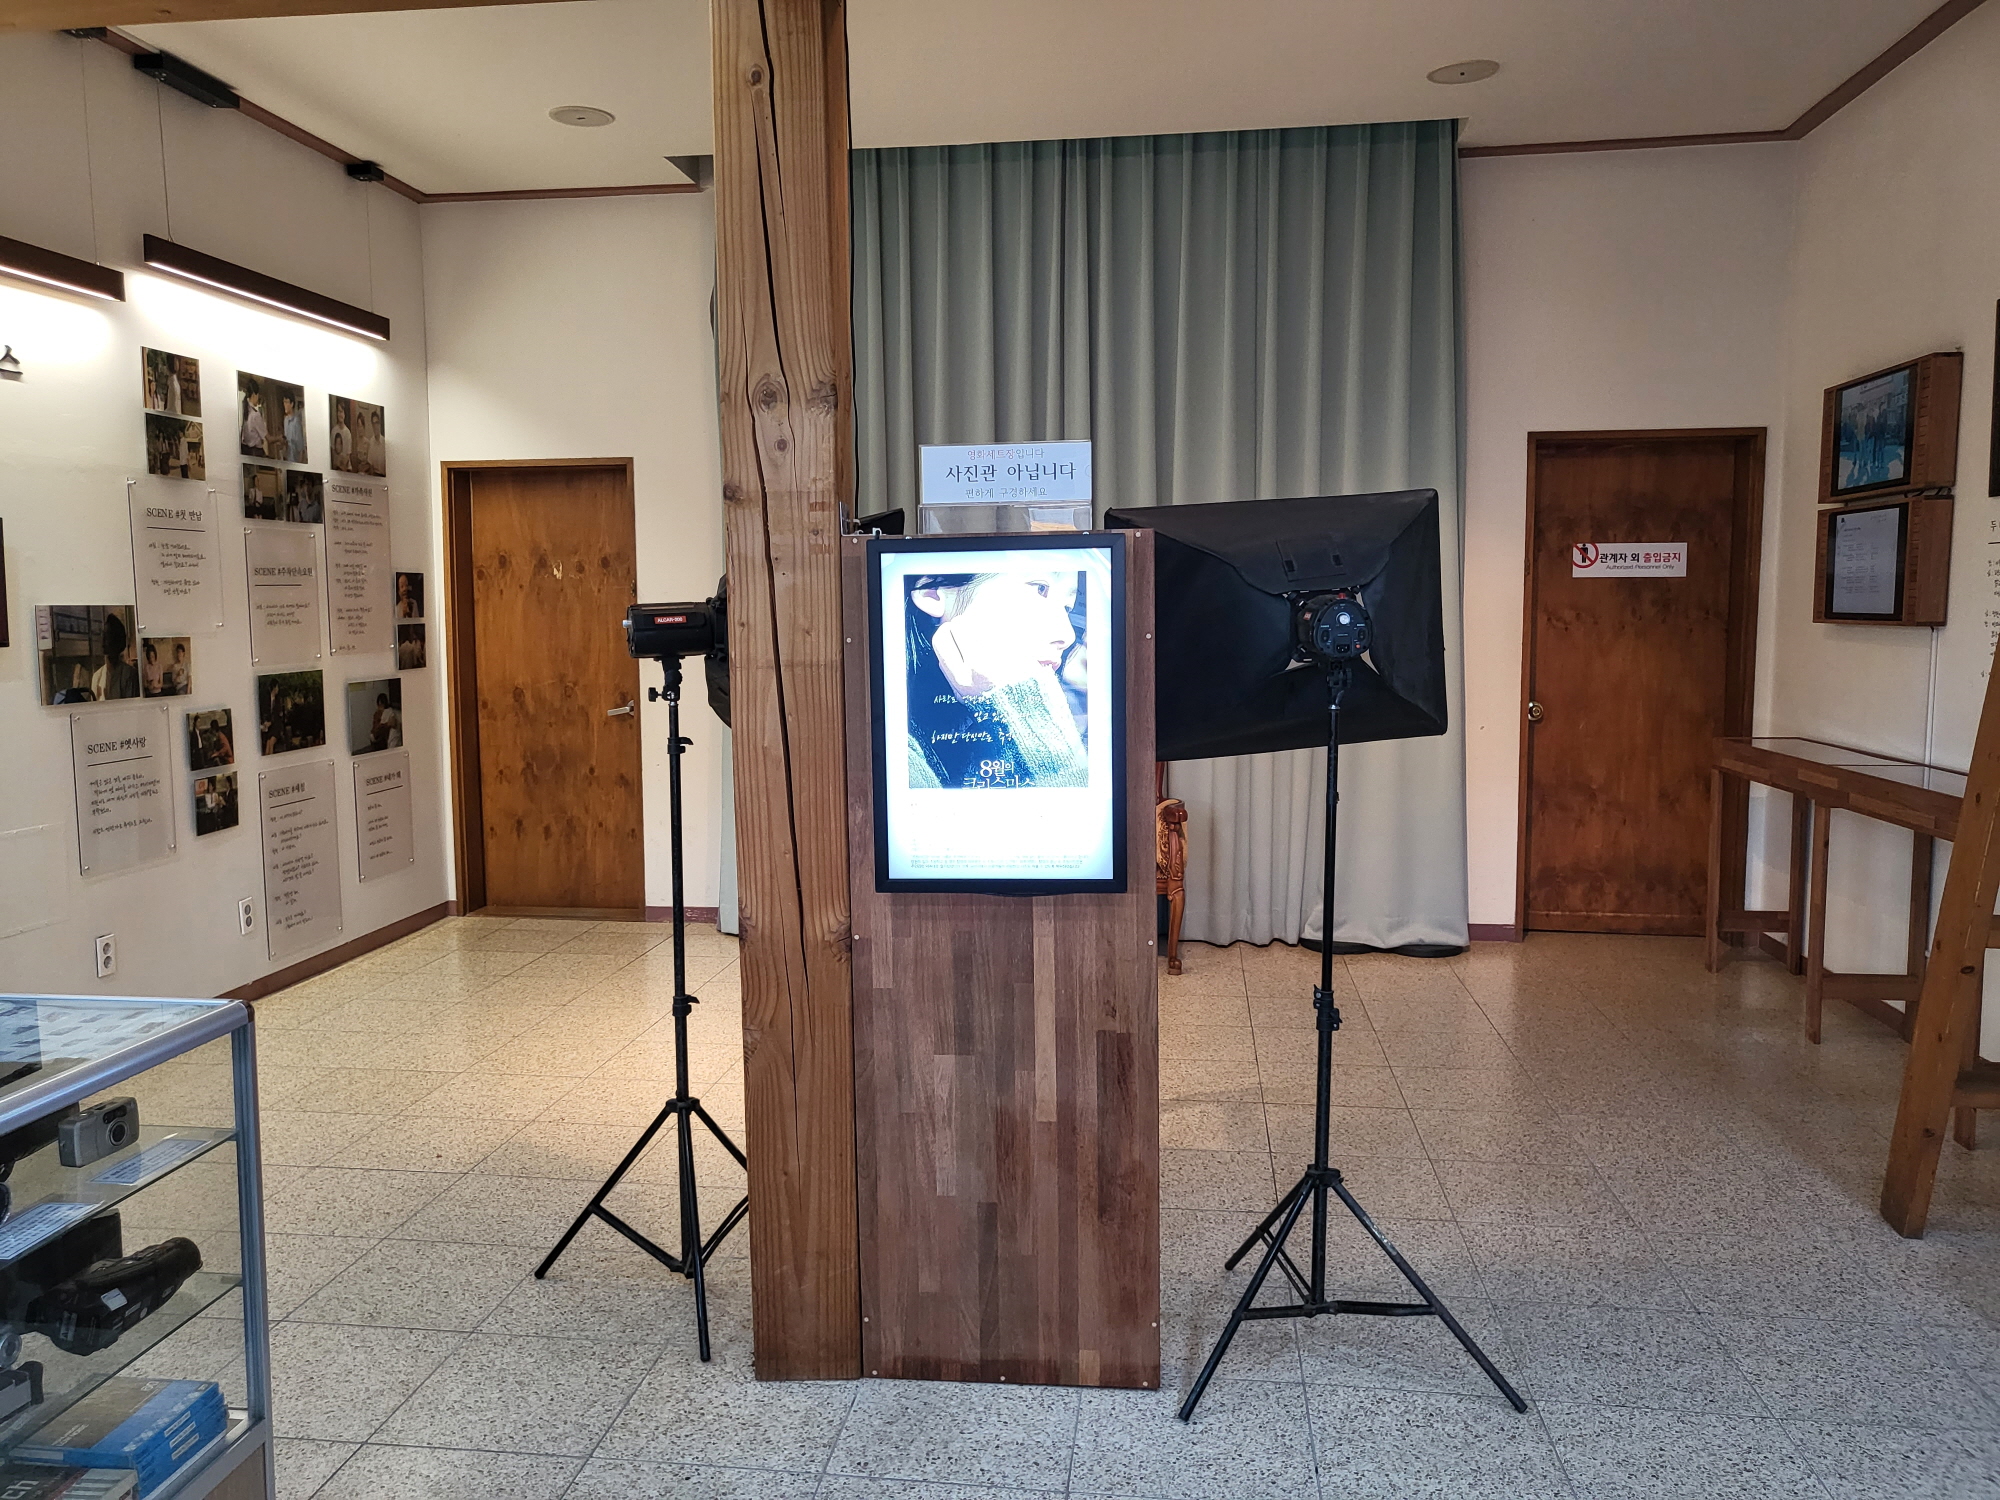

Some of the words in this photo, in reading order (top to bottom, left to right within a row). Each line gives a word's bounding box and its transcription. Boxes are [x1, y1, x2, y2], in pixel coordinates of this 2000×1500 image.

[967, 447, 1045, 460] 영화세트장입니다
[945, 464, 998, 483] 사진관
[1007, 462, 1077, 481] 아닙니다
[965, 488, 994, 499] 편하게
[999, 487, 1048, 498] 구경하세요
[147, 507, 174, 519] SCENE
[189, 510, 203, 521] 만남
[1599, 553, 1628, 563] 관계자
[1630, 553, 1640, 563] 외
[1643, 552, 1681, 563] 출입금지
[254, 567, 277, 576] SCENE
[931, 730, 960, 744] 하지만
[87, 742, 118, 754] SCENE
[980, 759, 1015, 778] 8월의
[962, 775, 1036, 789] 크리스마스
[269, 786, 291, 798] SCENE
